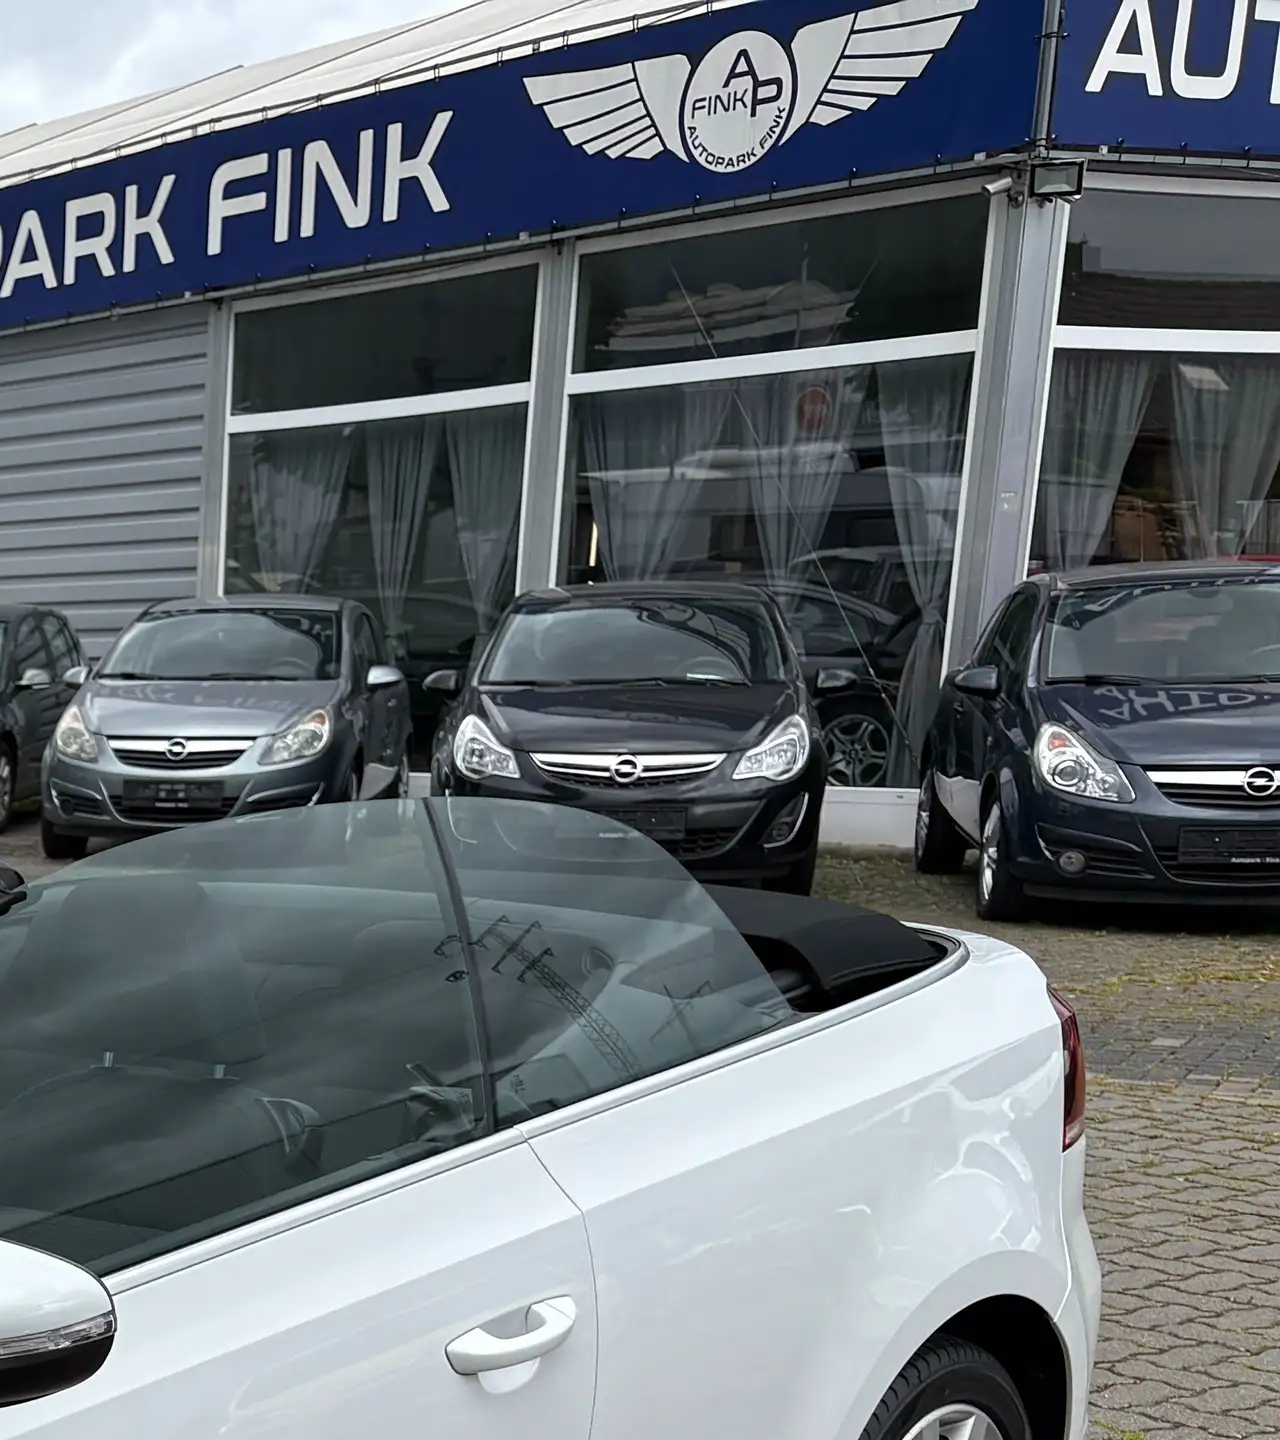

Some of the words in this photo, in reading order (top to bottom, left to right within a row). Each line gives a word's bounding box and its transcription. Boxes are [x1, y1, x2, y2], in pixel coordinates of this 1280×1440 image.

[691, 87, 749, 119] FINK
[686, 125, 757, 169] AUTOPARK
[759, 106, 786, 149] FINK
[206, 110, 454, 256] FINK
